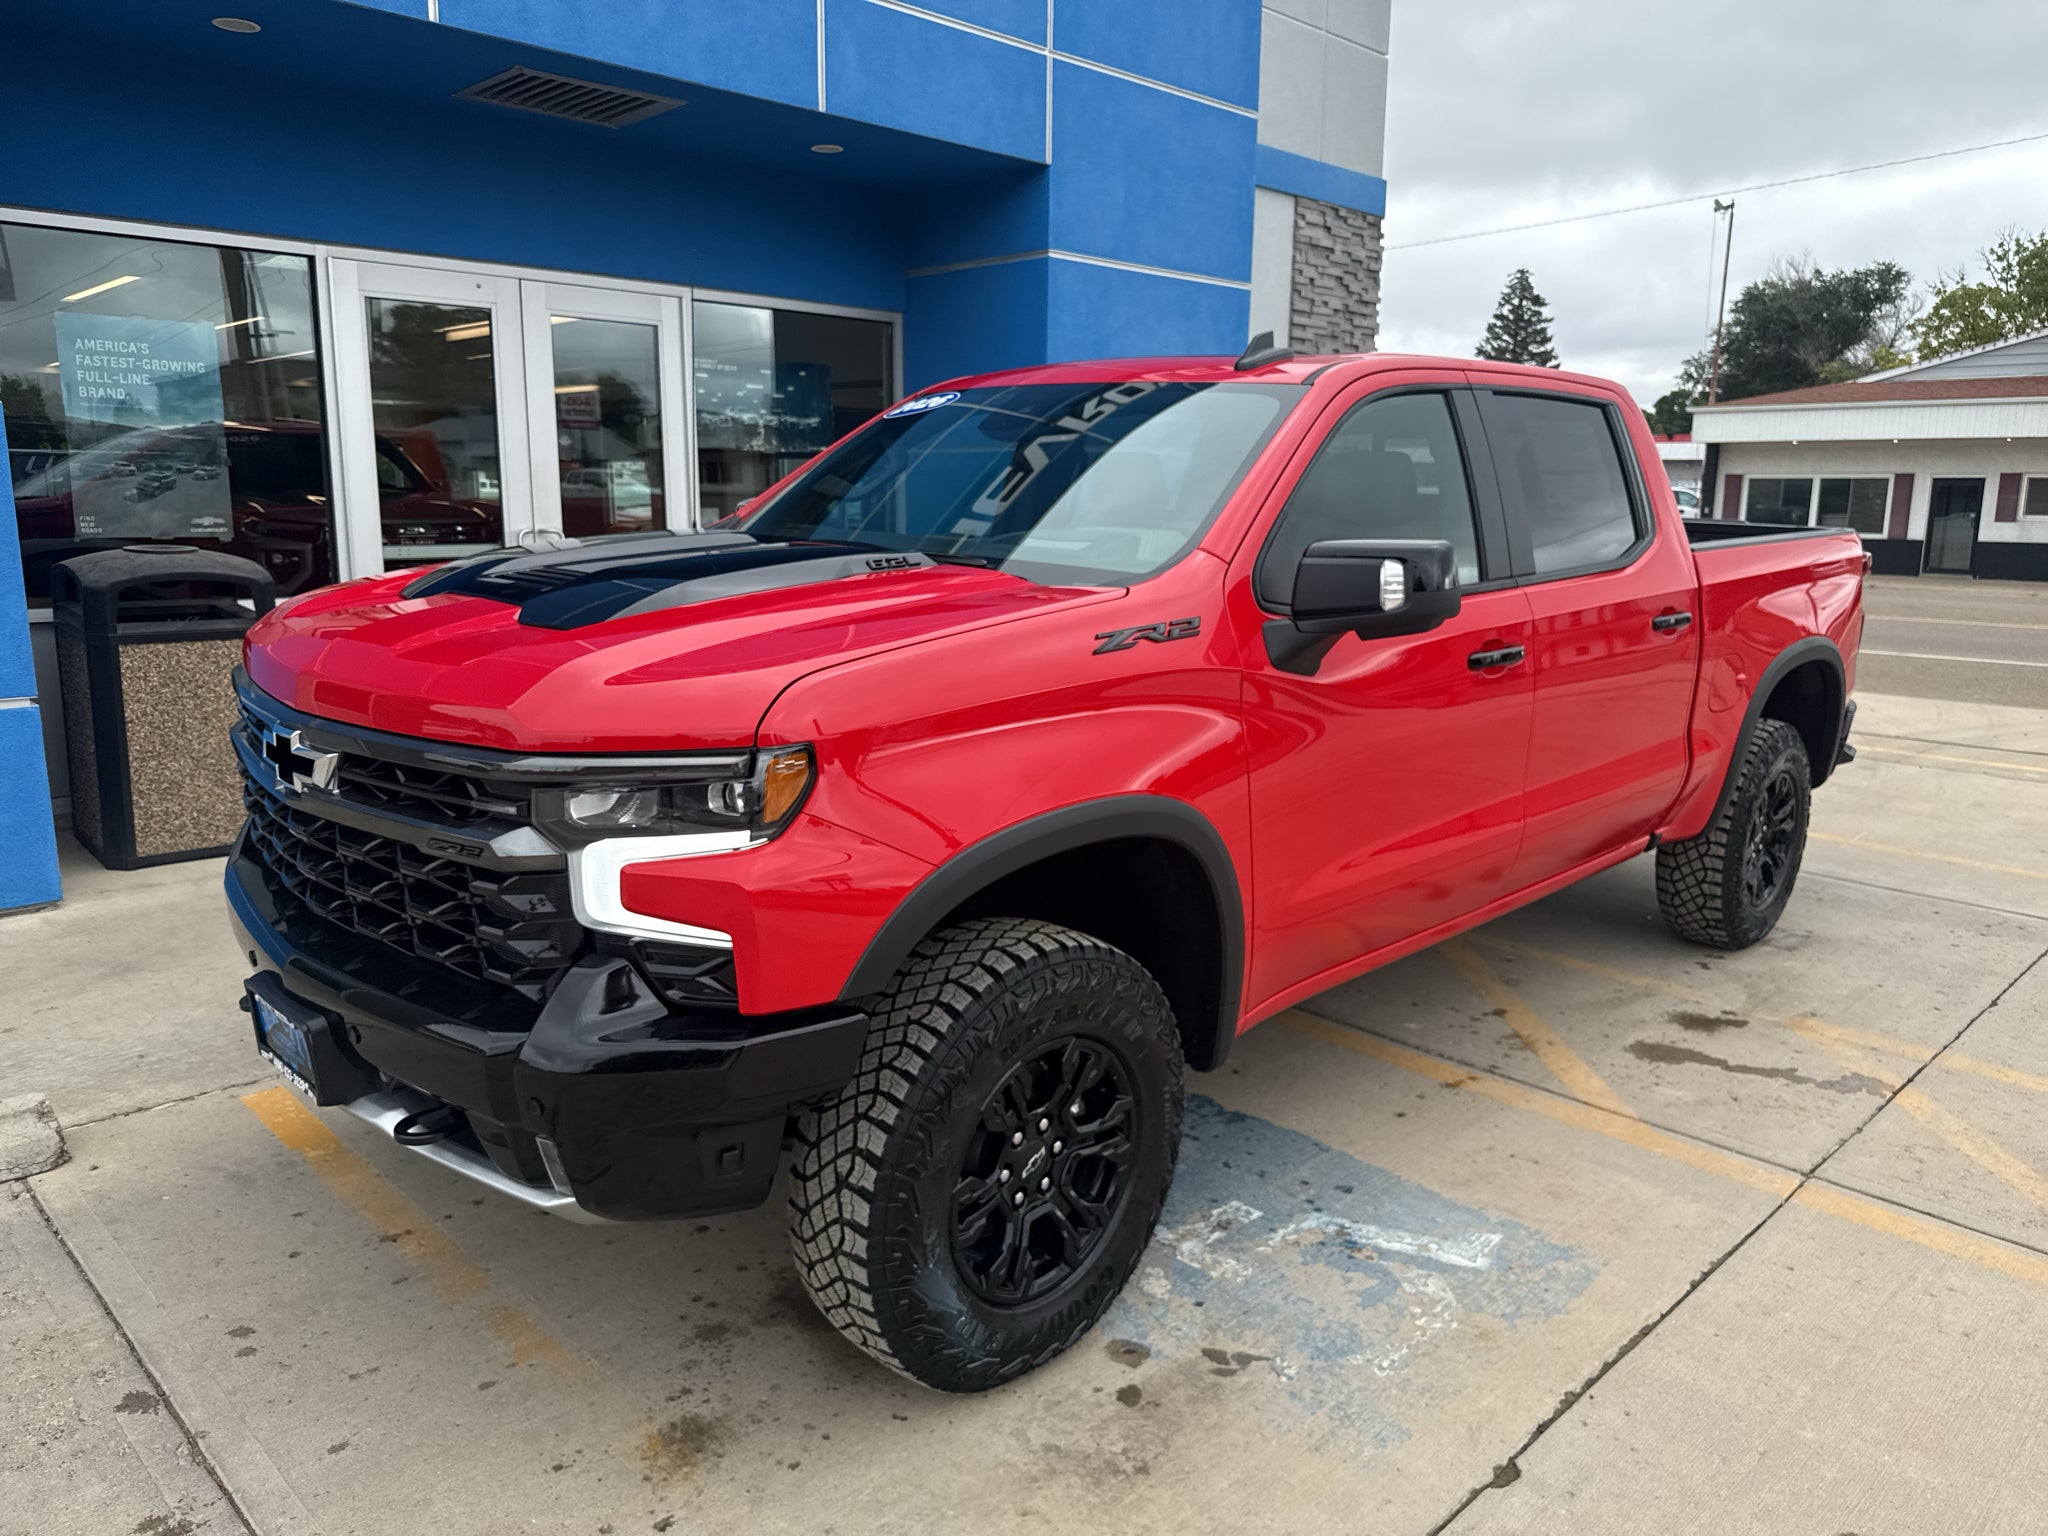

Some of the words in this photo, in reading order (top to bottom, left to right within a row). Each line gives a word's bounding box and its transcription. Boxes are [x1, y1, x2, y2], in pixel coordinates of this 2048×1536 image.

[75, 338, 149, 354] AMERICA'S
[76, 354, 206, 373] FASTEST-GROWING
[77, 370, 151, 385] FULL-LINE
[79, 386, 130, 400] BRAND.
[1092, 616, 1201, 656] ZR2
